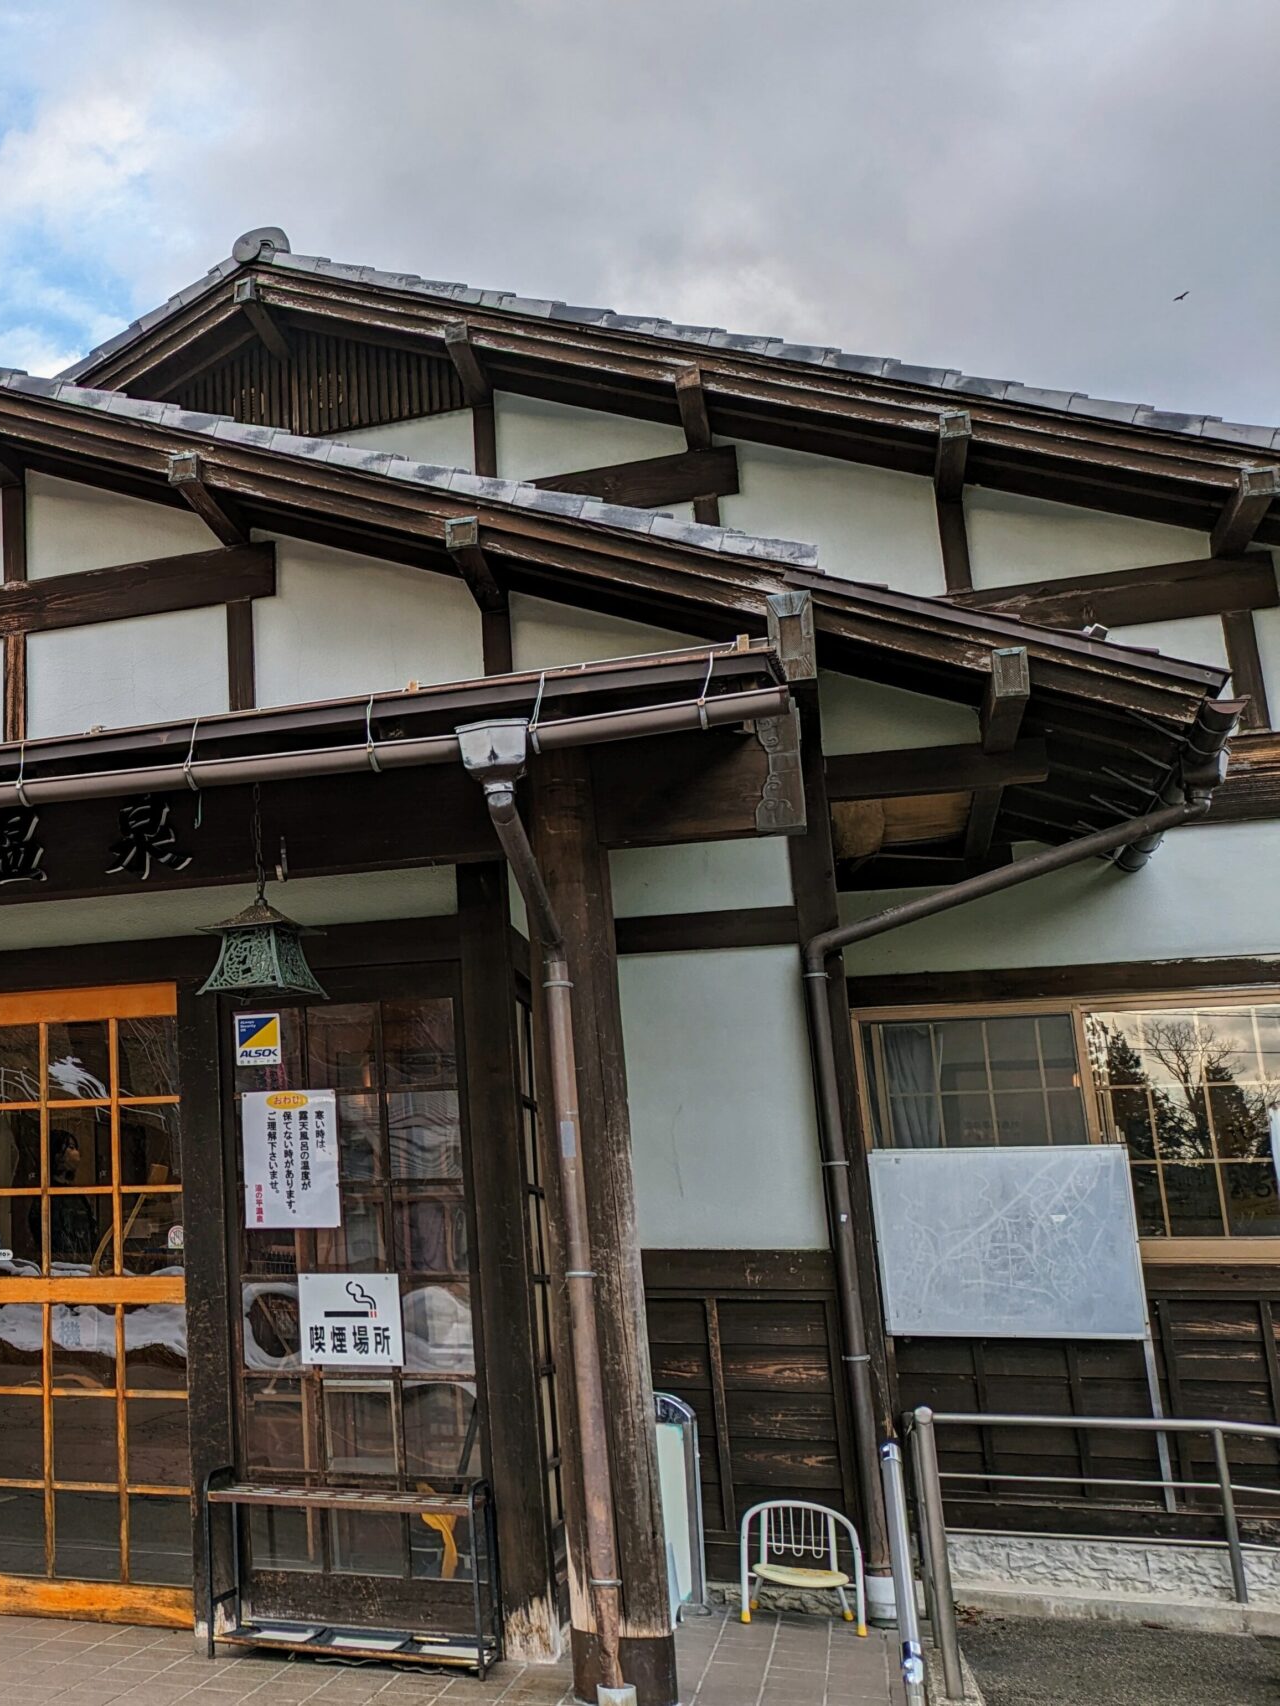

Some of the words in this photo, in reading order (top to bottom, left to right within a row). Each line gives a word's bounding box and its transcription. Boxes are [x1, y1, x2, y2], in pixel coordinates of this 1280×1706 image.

[240, 1049, 278, 1058] ALSOK
[266, 1111, 280, 1194] ご理解下さいませ。
[298, 1110, 311, 1191] 露天風呂の温度が
[314, 1110, 326, 1153] 寒い時は、
[282, 1111, 296, 1214] 保てない時があります。
[255, 1184, 264, 1224] 湯の平温泉
[308, 1324, 391, 1356] 喫煙場所
